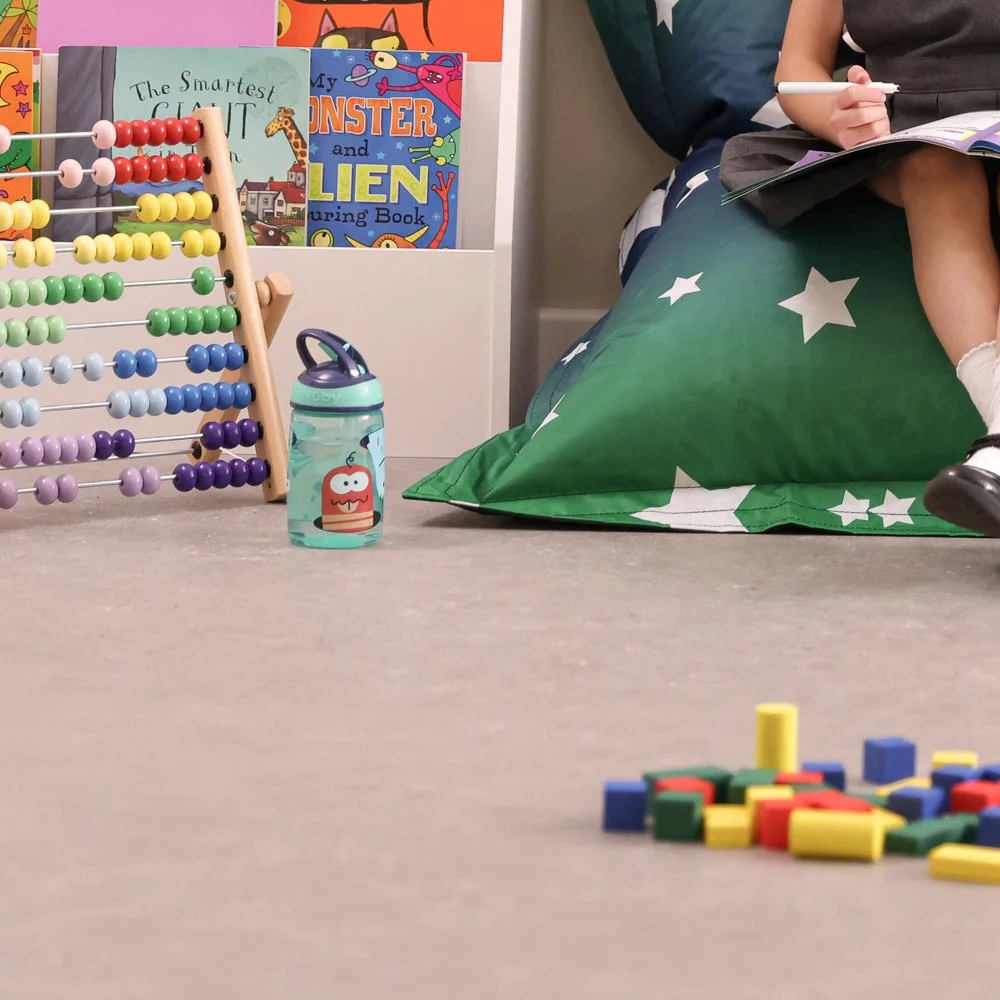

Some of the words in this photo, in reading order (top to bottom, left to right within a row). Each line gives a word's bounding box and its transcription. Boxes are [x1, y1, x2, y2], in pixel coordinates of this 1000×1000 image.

[129, 80, 170, 102] The
[180, 70, 275, 103] Smartest
[332, 139, 369, 157] and
[309, 163, 429, 205] LIEN
[308, 206, 369, 227] uring
[374, 207, 426, 225] Book
